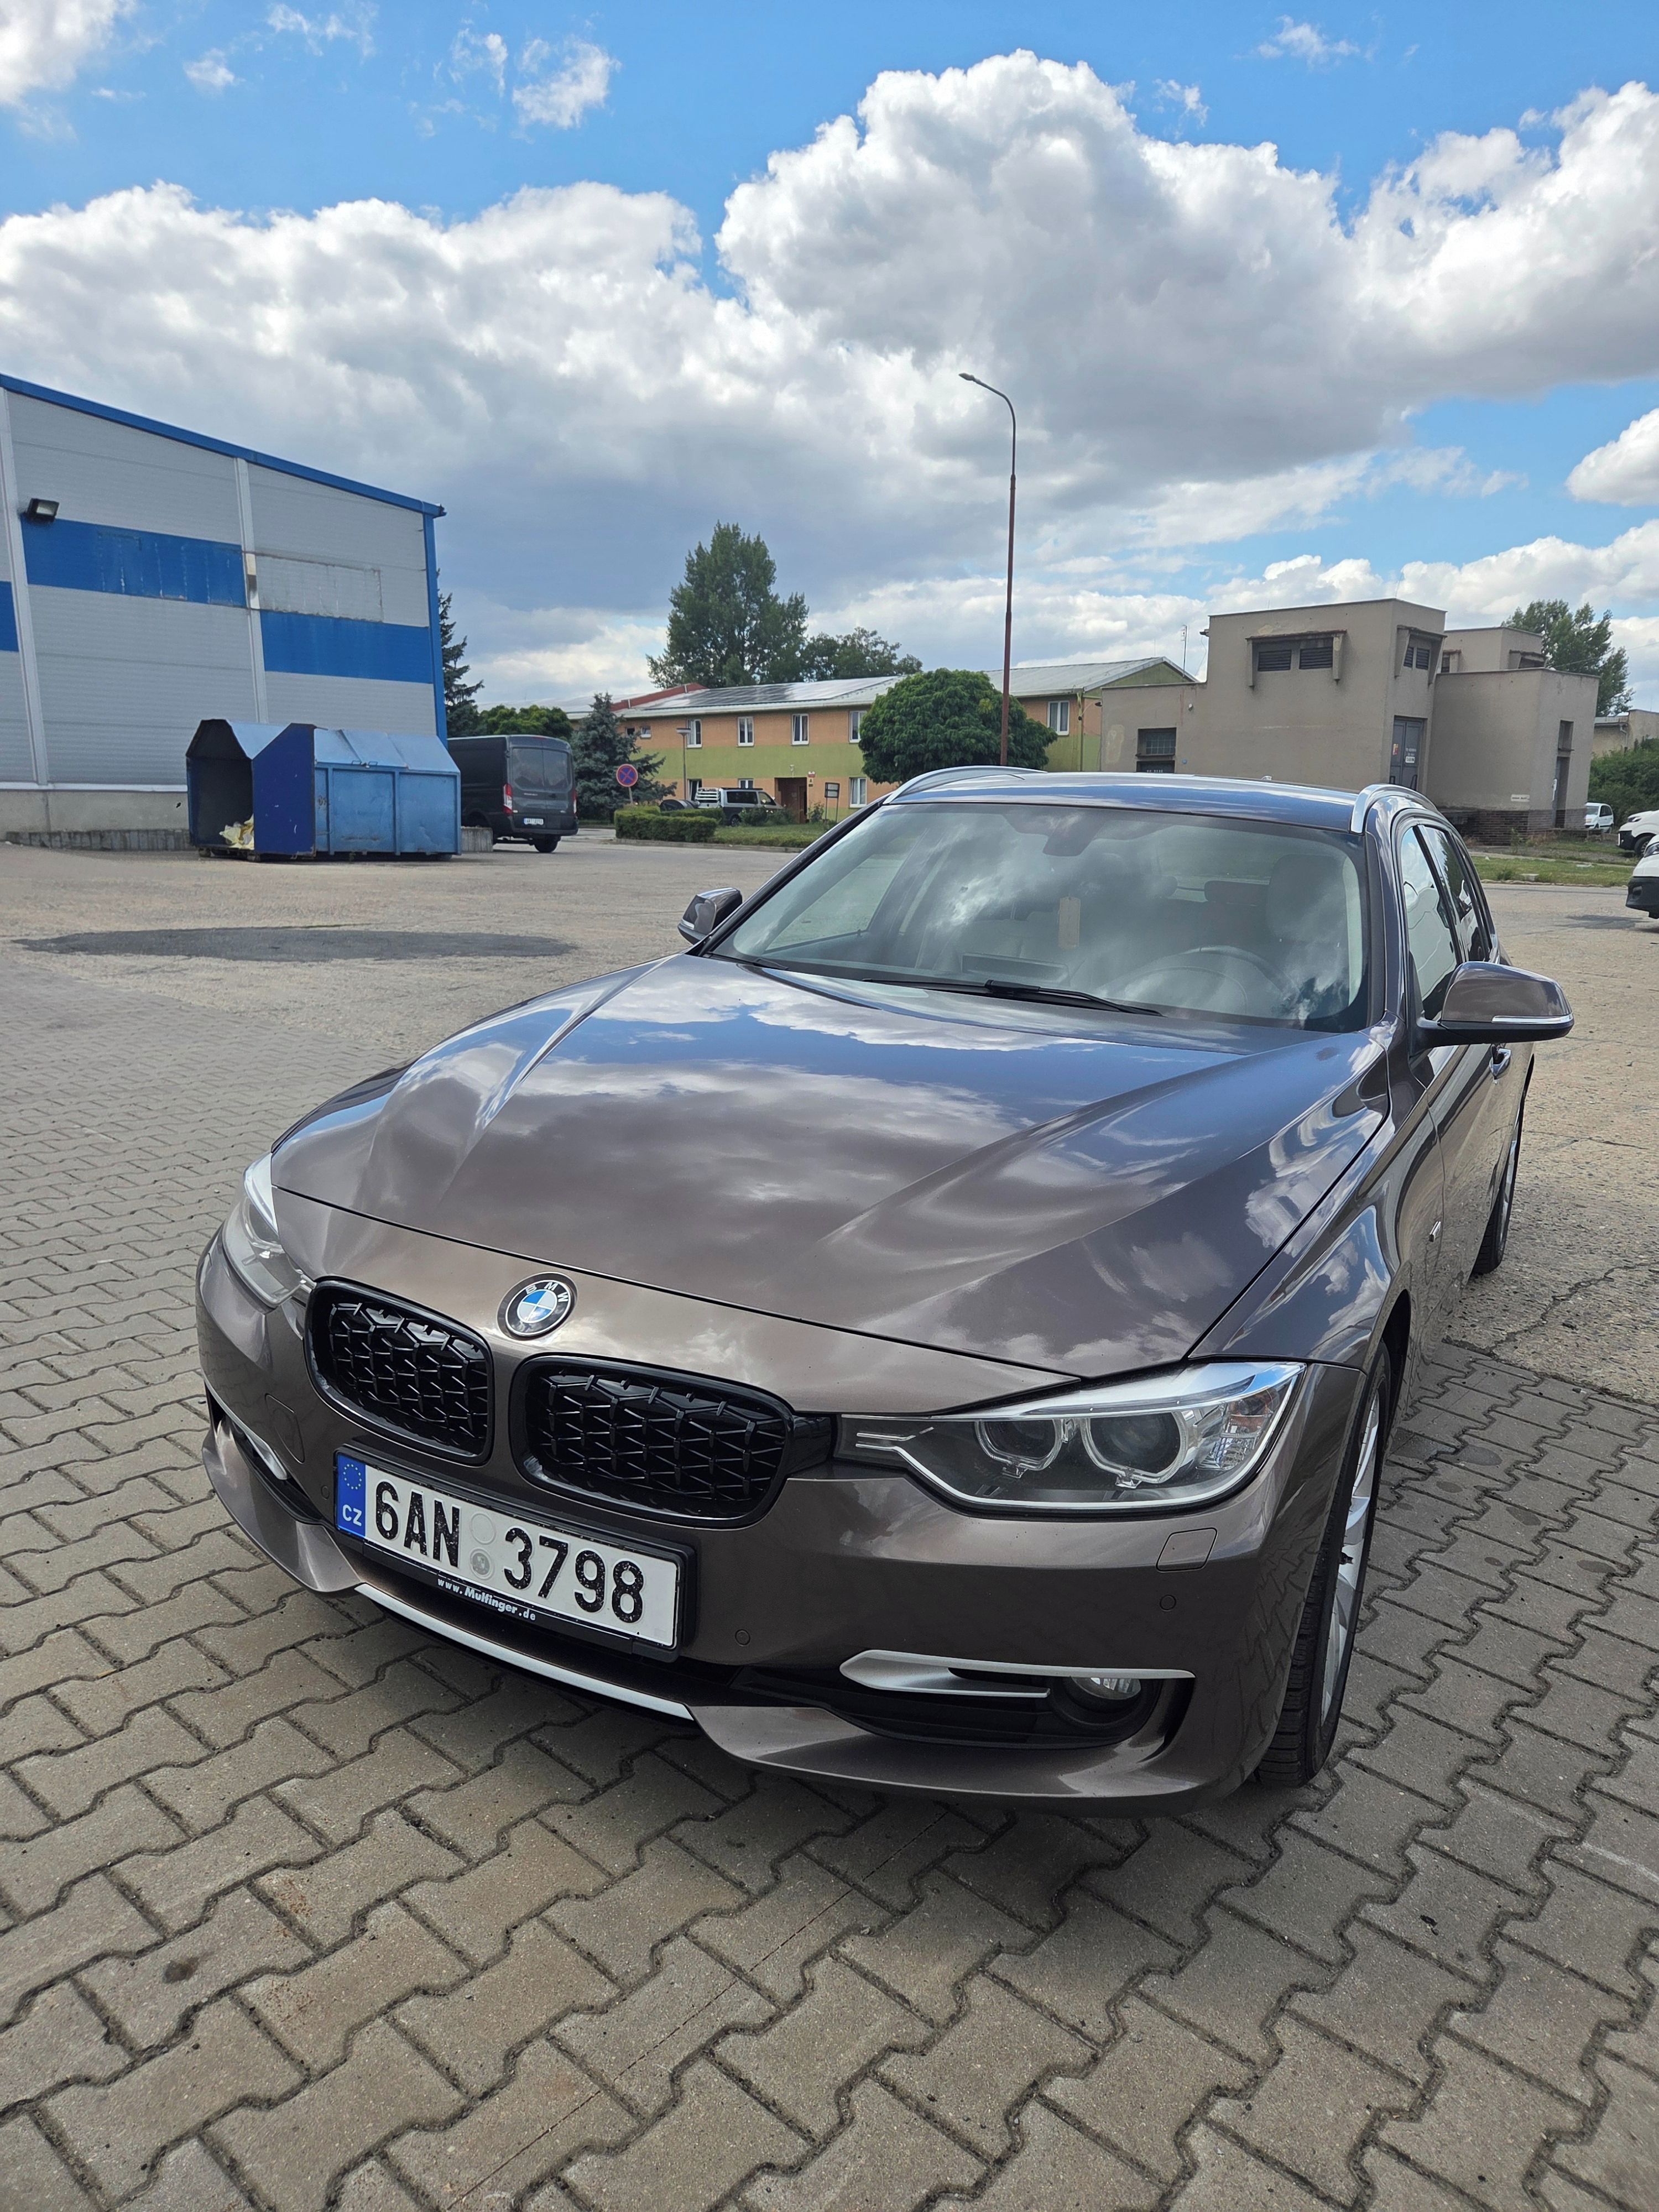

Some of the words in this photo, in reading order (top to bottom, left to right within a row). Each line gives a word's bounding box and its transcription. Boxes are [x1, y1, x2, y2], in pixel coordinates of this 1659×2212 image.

[526, 1282, 568, 1302] BMW
[342, 1504, 362, 1526] CZ
[375, 1480, 461, 1568] 6AN
[504, 1527, 644, 1624] 3798
